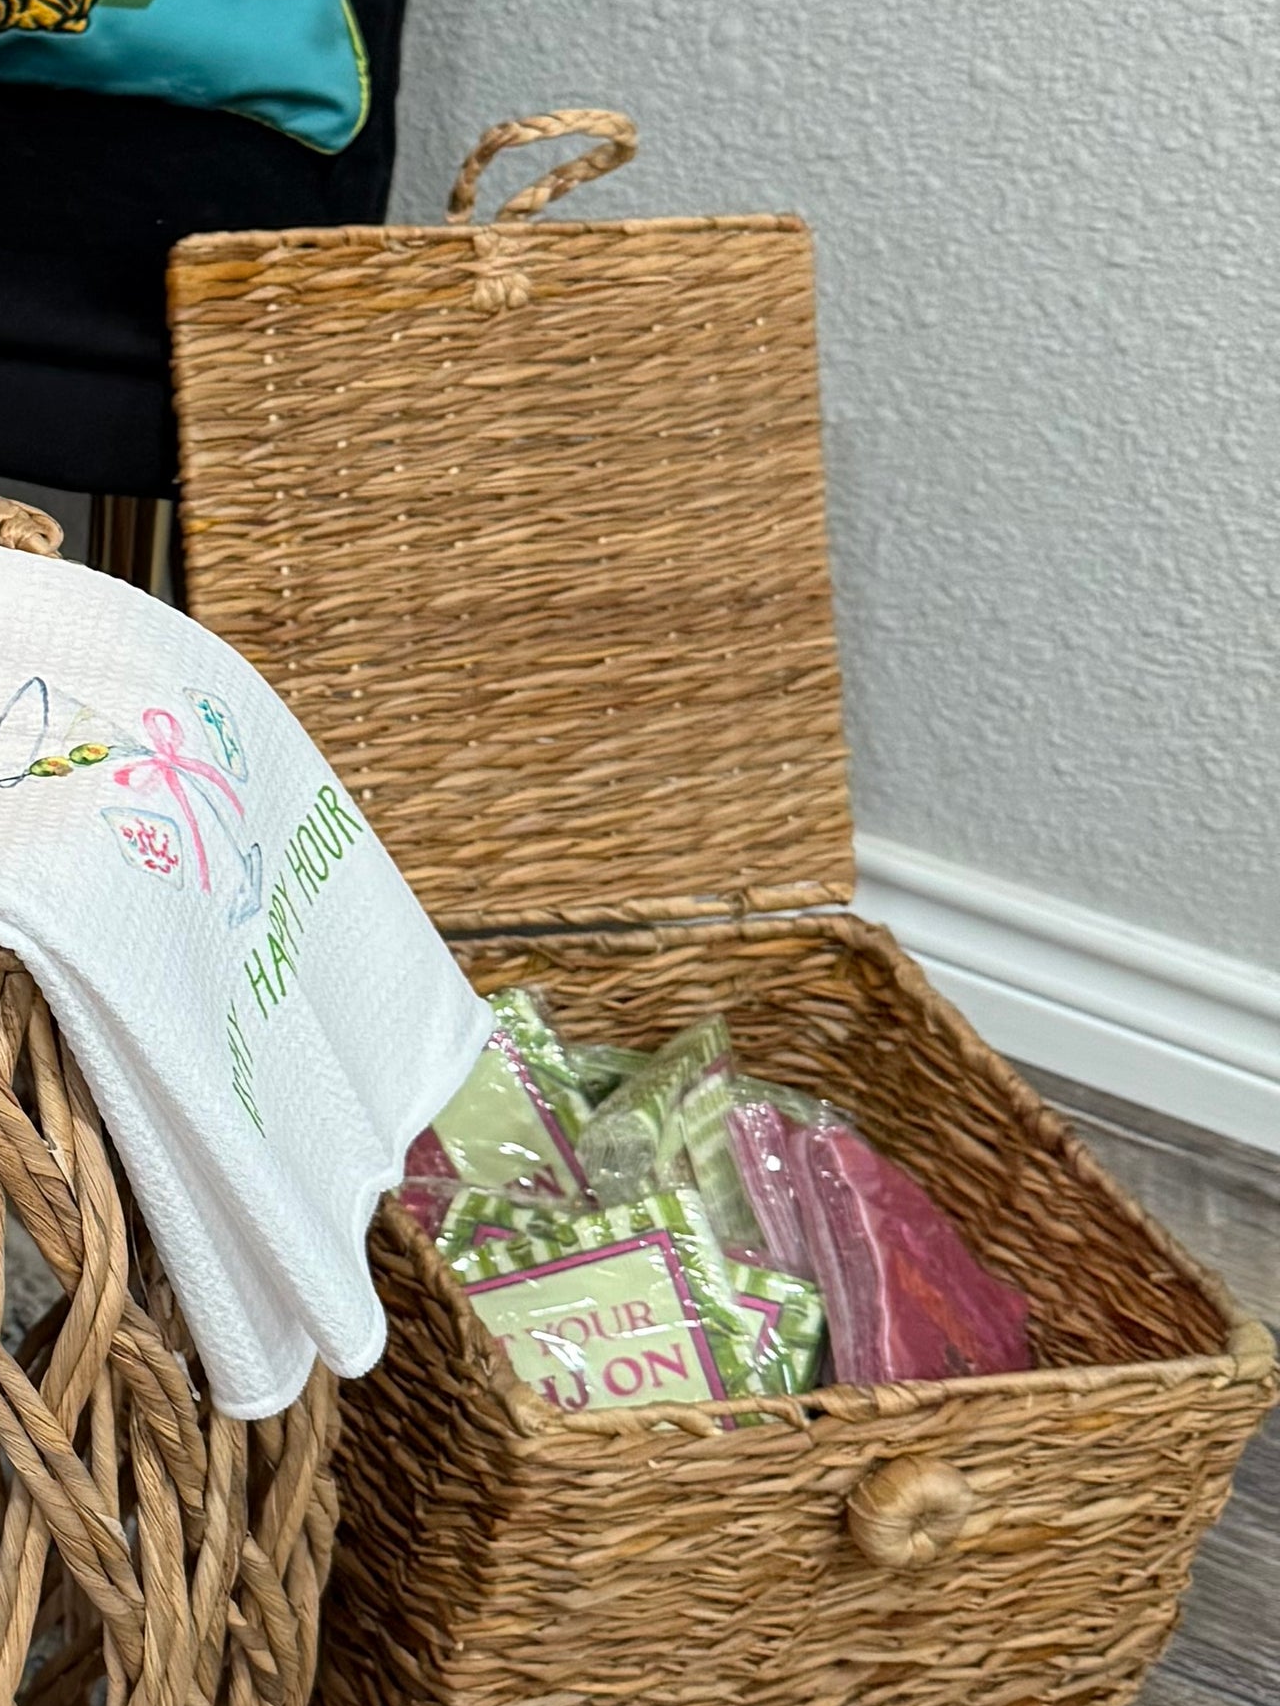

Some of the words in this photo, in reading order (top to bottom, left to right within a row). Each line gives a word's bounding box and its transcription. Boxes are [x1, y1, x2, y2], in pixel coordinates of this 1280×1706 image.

[243, 870, 305, 1021] HAPPY
[284, 784, 365, 910] HOUR
[603, 1342, 690, 1398] ON
